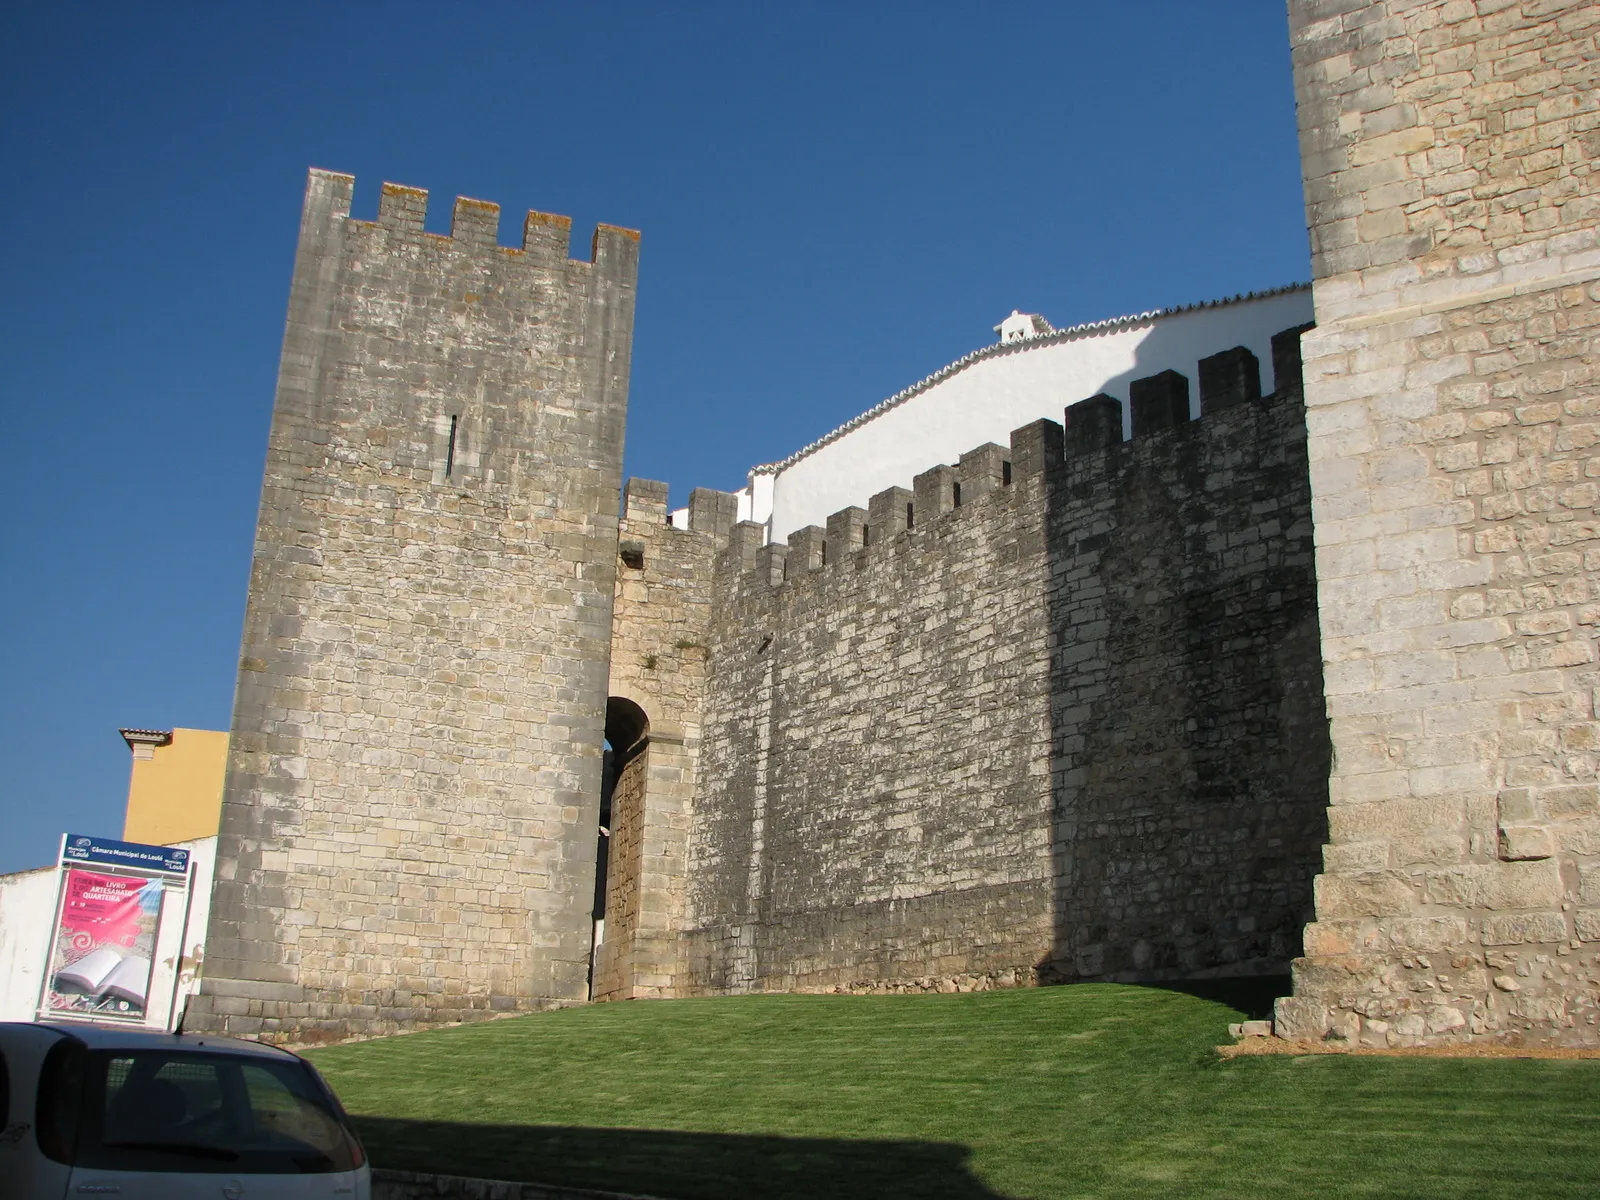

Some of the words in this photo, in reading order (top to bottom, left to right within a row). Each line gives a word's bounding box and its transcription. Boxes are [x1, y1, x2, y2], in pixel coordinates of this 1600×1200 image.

[114, 849, 139, 858] Municipal
[90, 886, 133, 896] ARTESANATO
[83, 892, 120, 902] QUARTEIRA
